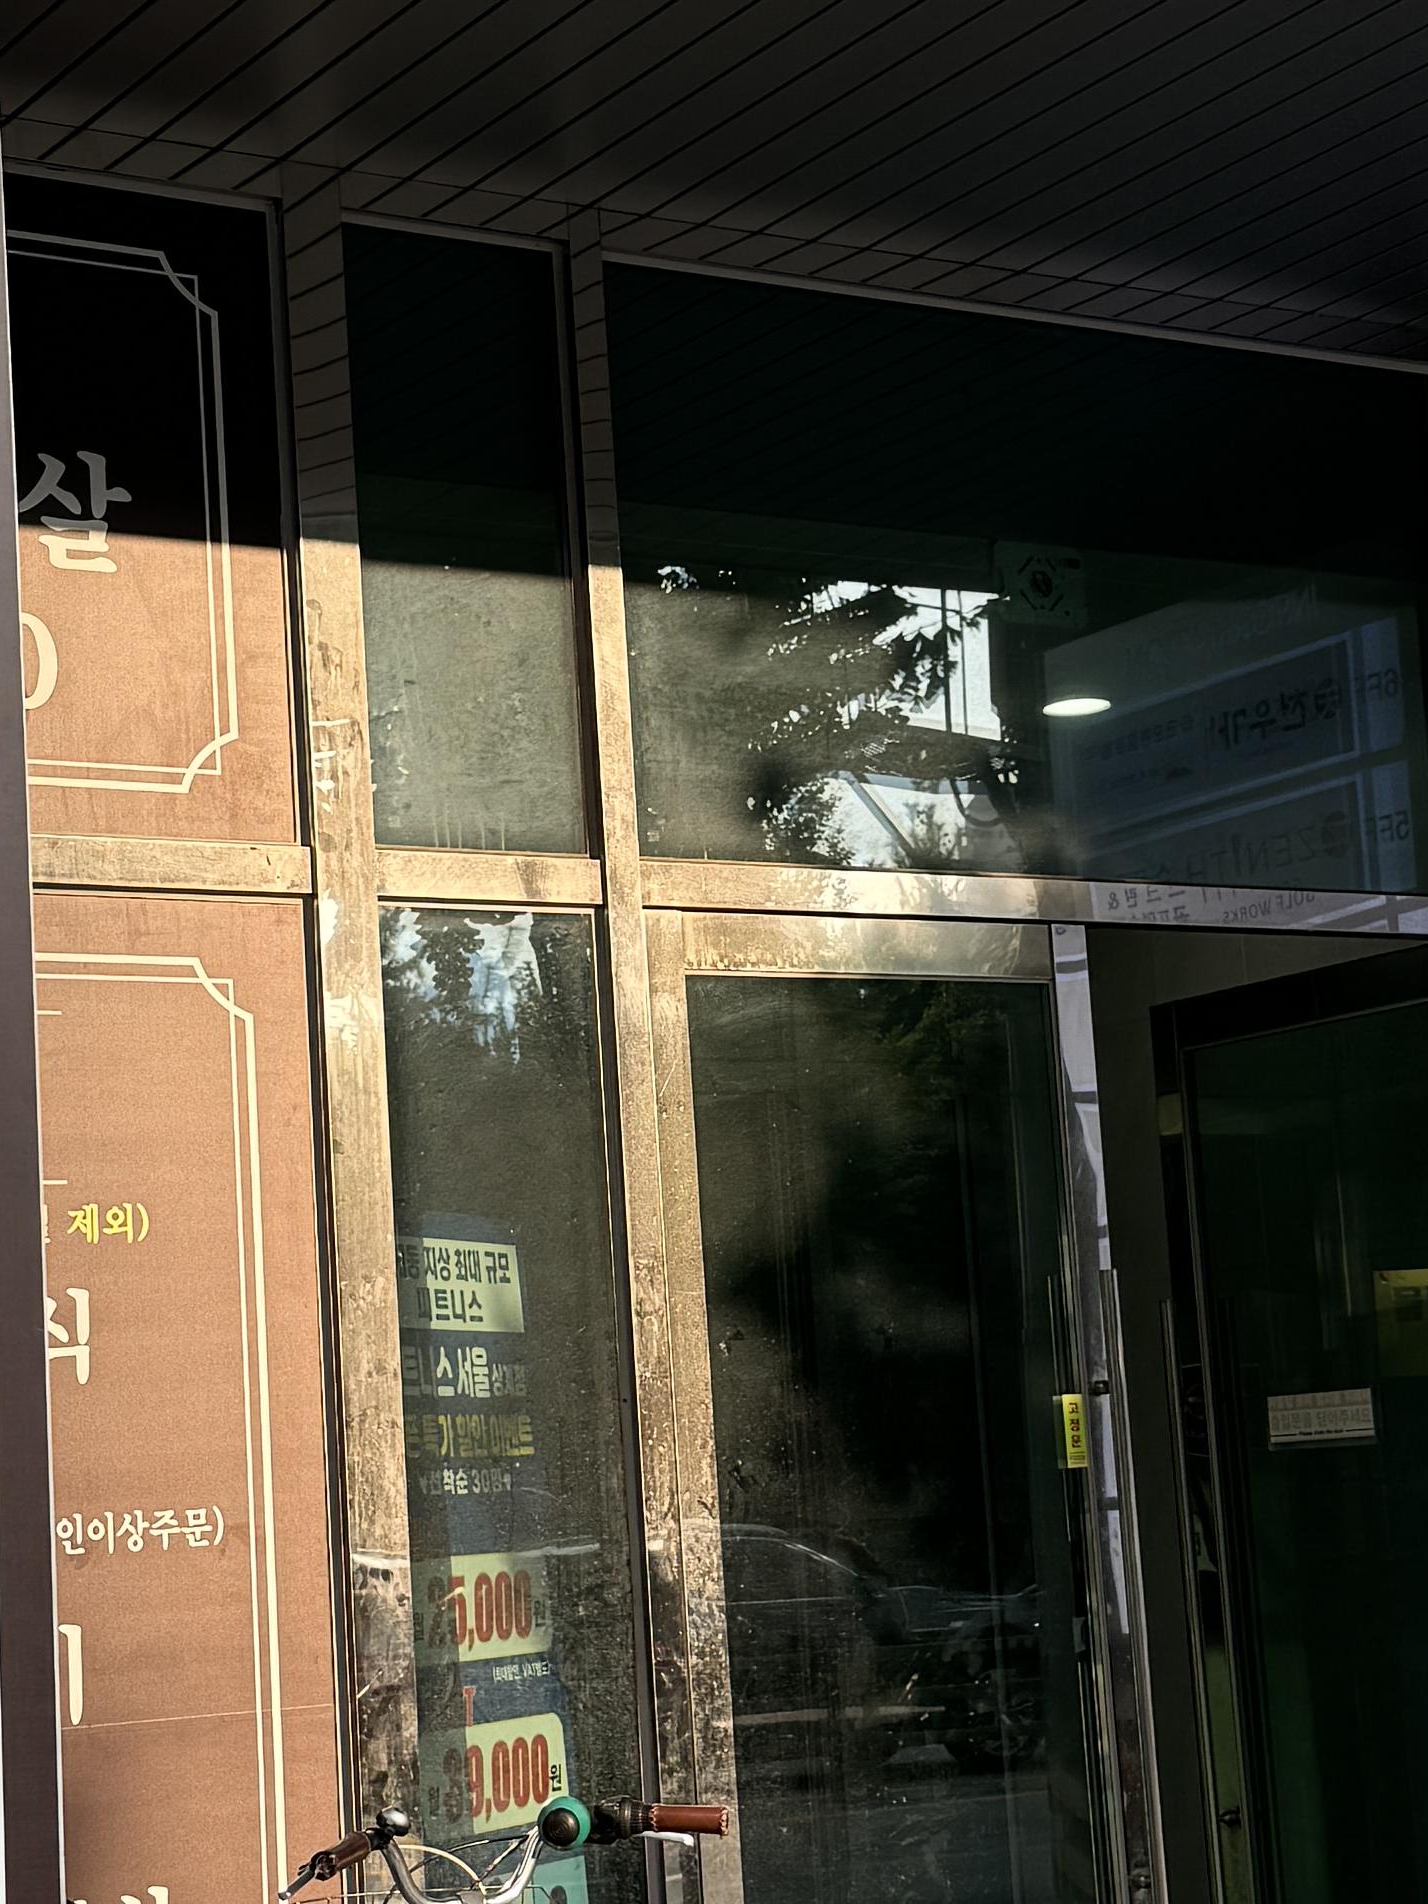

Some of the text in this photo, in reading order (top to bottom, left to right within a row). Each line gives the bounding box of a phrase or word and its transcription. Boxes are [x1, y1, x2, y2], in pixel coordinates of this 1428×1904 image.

[18, 450, 132, 574] 살
[67, 1202, 150, 1245] 제외)
[45, 1288, 90, 1385] 식
[56, 1506, 224, 1556] 인이상주문)
